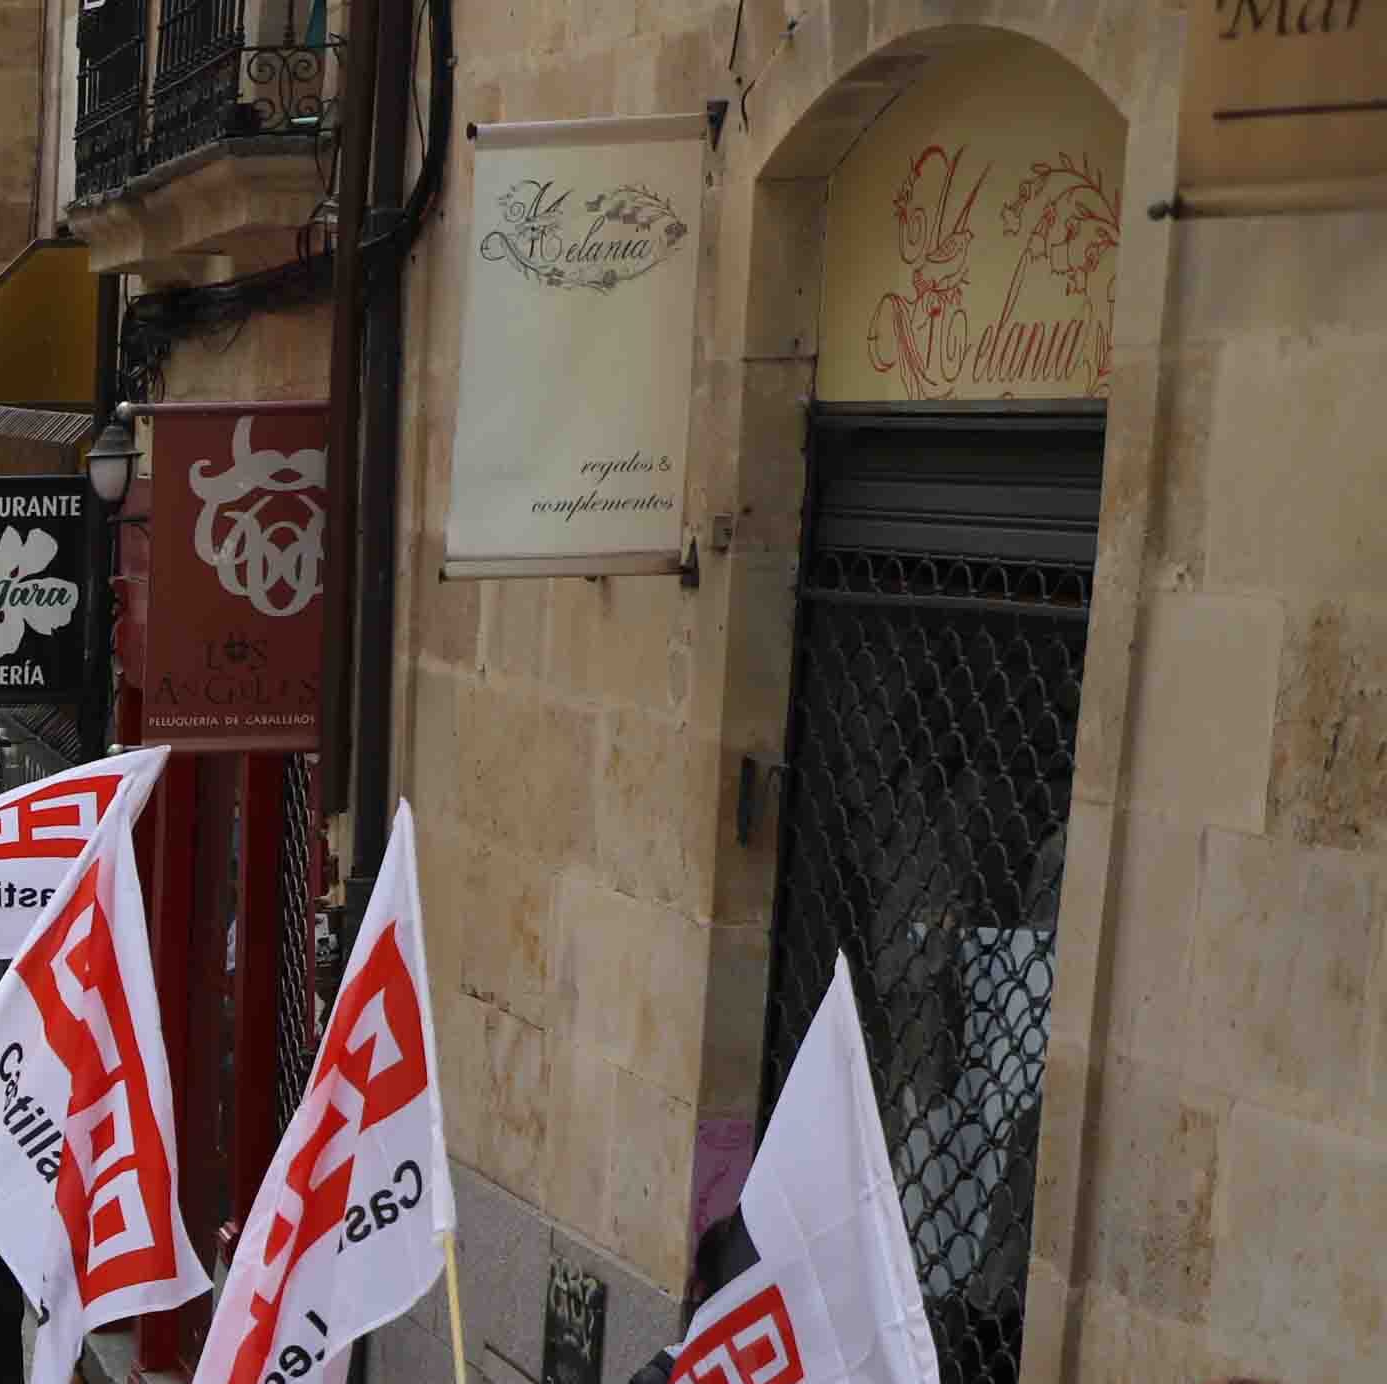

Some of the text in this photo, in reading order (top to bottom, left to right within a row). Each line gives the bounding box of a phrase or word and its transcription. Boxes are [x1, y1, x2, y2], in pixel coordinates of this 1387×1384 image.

[580, 449, 671, 482] regalos &
[531, 490, 675, 522] complementos
[225, 713, 239, 727] DE
